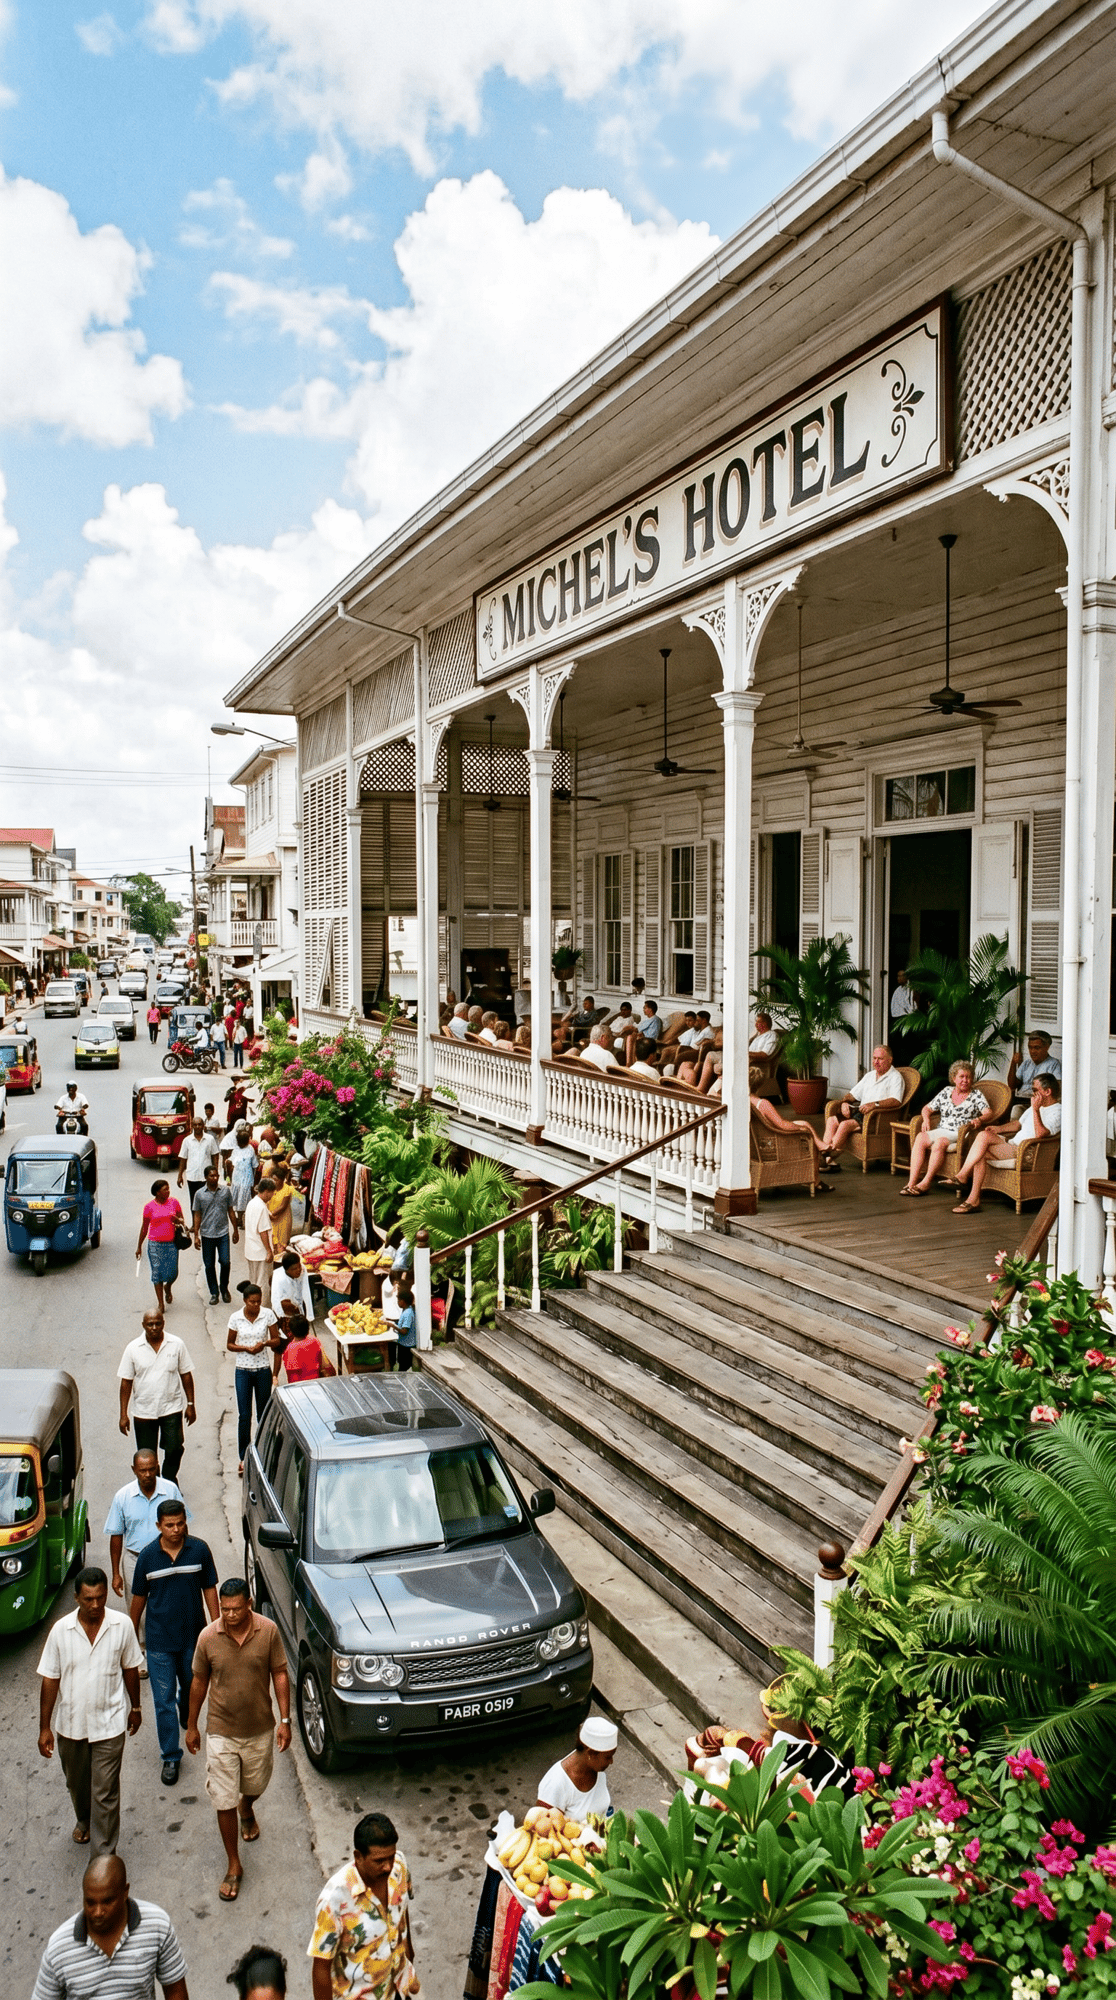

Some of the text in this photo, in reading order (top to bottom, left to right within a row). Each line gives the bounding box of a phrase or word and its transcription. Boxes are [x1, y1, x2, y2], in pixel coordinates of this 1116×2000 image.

[501, 392, 870, 650] MICHEL'S HOTEL
[478, 1623, 531, 1640] ROVER
[444, 1703, 481, 1720] PABR
